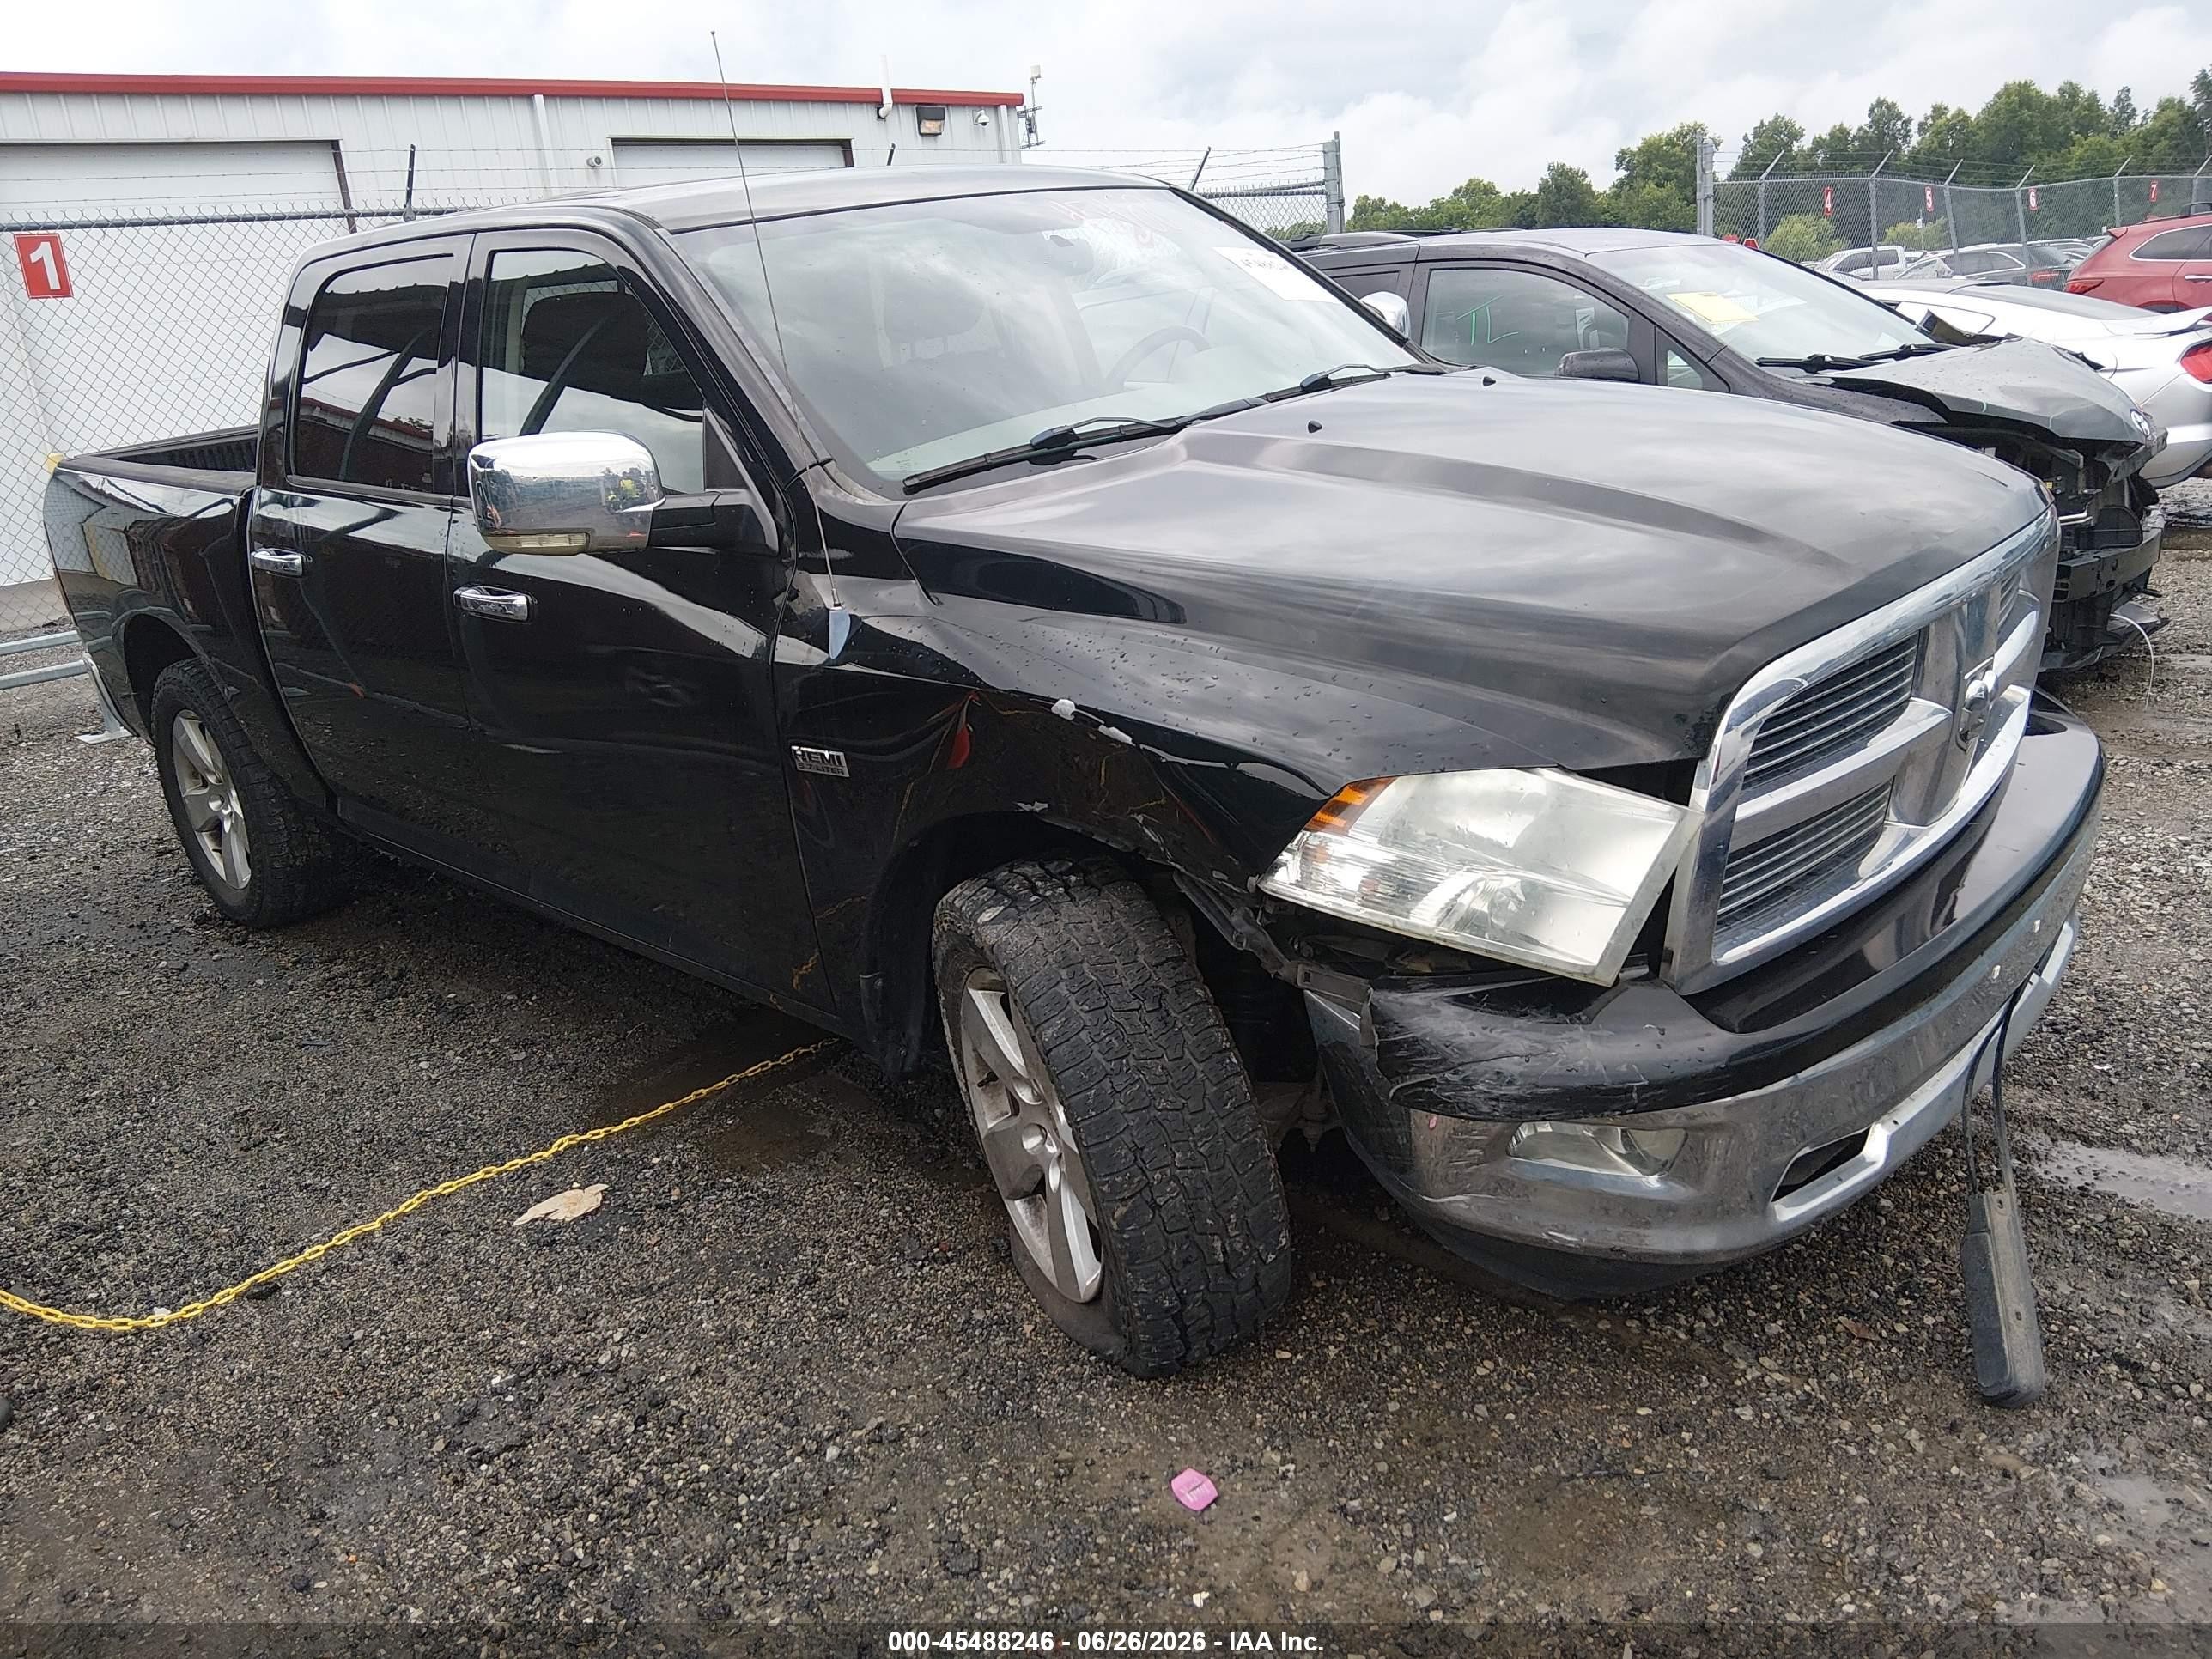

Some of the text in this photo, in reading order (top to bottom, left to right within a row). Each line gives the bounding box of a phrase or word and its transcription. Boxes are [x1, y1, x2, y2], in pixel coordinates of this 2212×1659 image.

[1925, 189, 1933, 209] 5
[2029, 191, 2037, 208] 6
[2150, 183, 2157, 199] 7
[1825, 190, 1832, 212] 4
[29, 241, 61, 290] 1
[793, 750, 844, 767] HEMI
